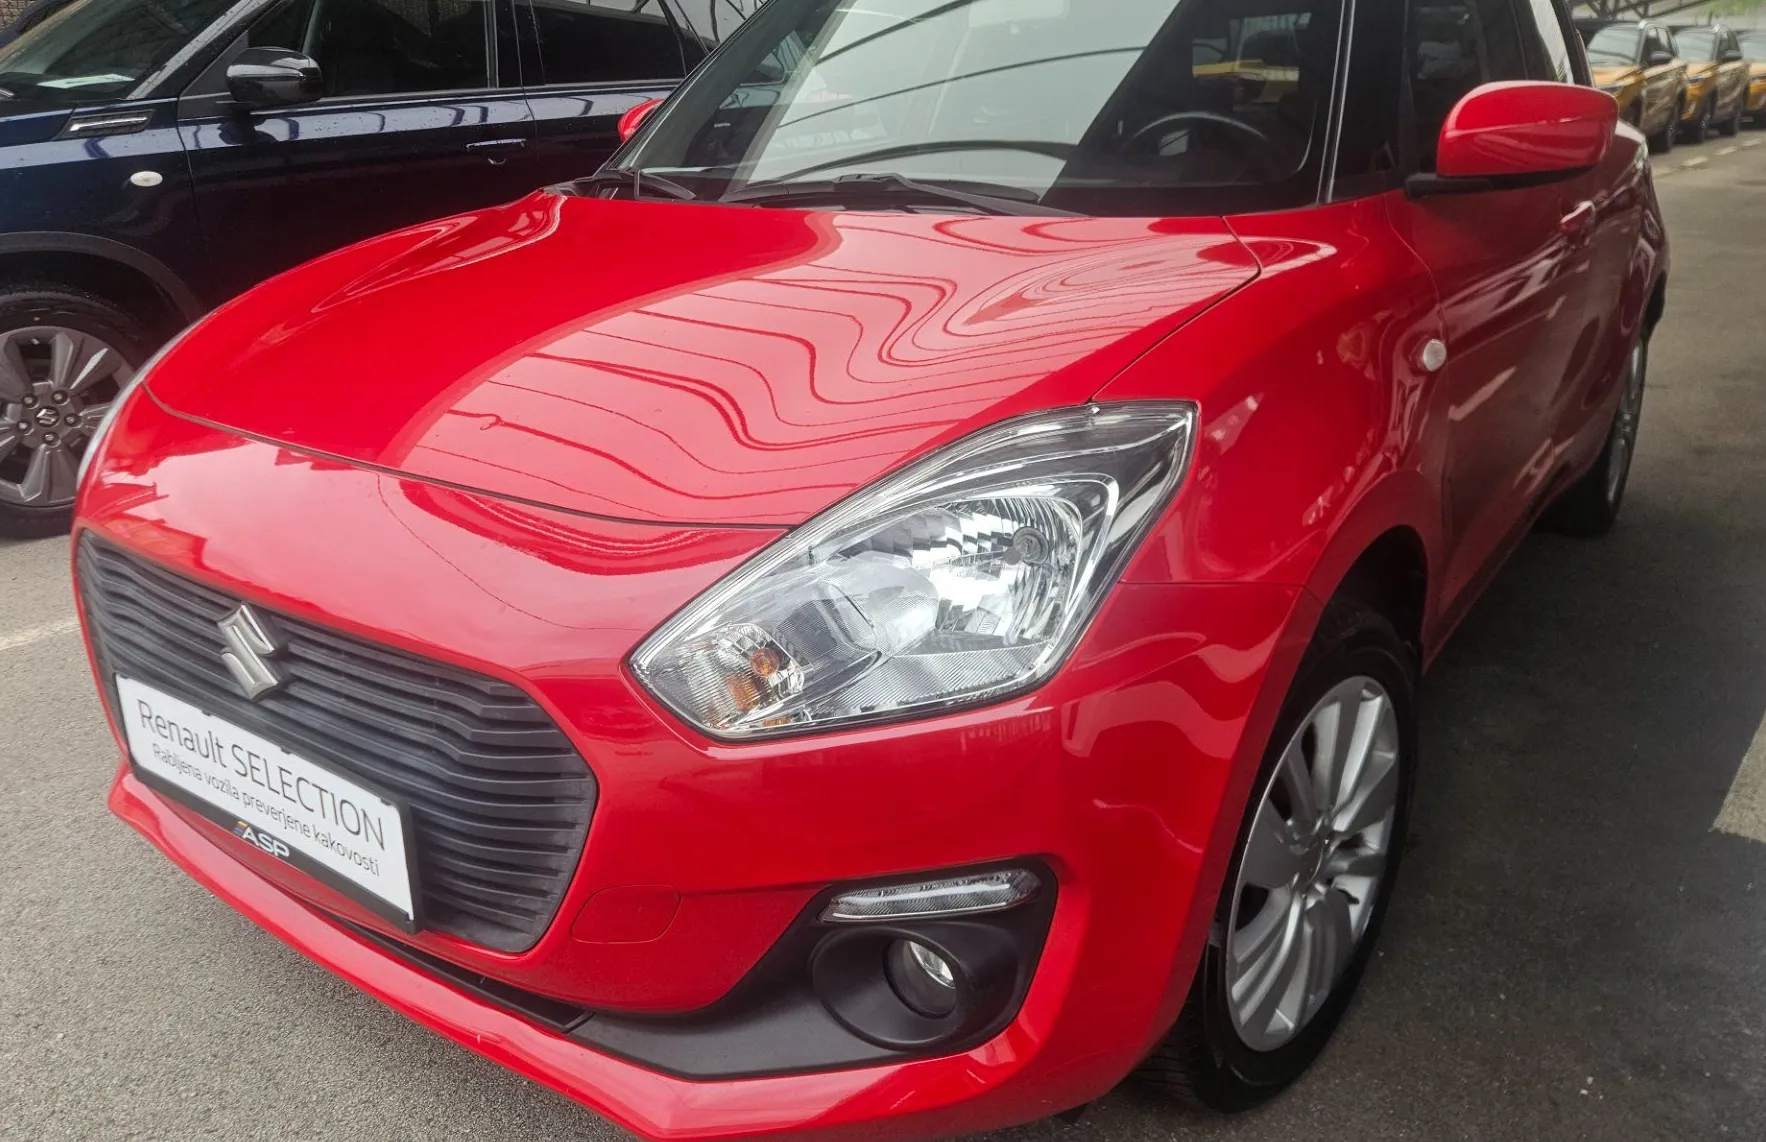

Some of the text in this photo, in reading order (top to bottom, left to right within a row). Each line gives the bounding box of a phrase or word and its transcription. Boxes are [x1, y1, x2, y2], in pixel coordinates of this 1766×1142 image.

[137, 699, 386, 852] Renault SELECTION
[152, 743, 380, 877] Rabljena vozila preverjene kakovosti
[242, 825, 290, 859] ASP
